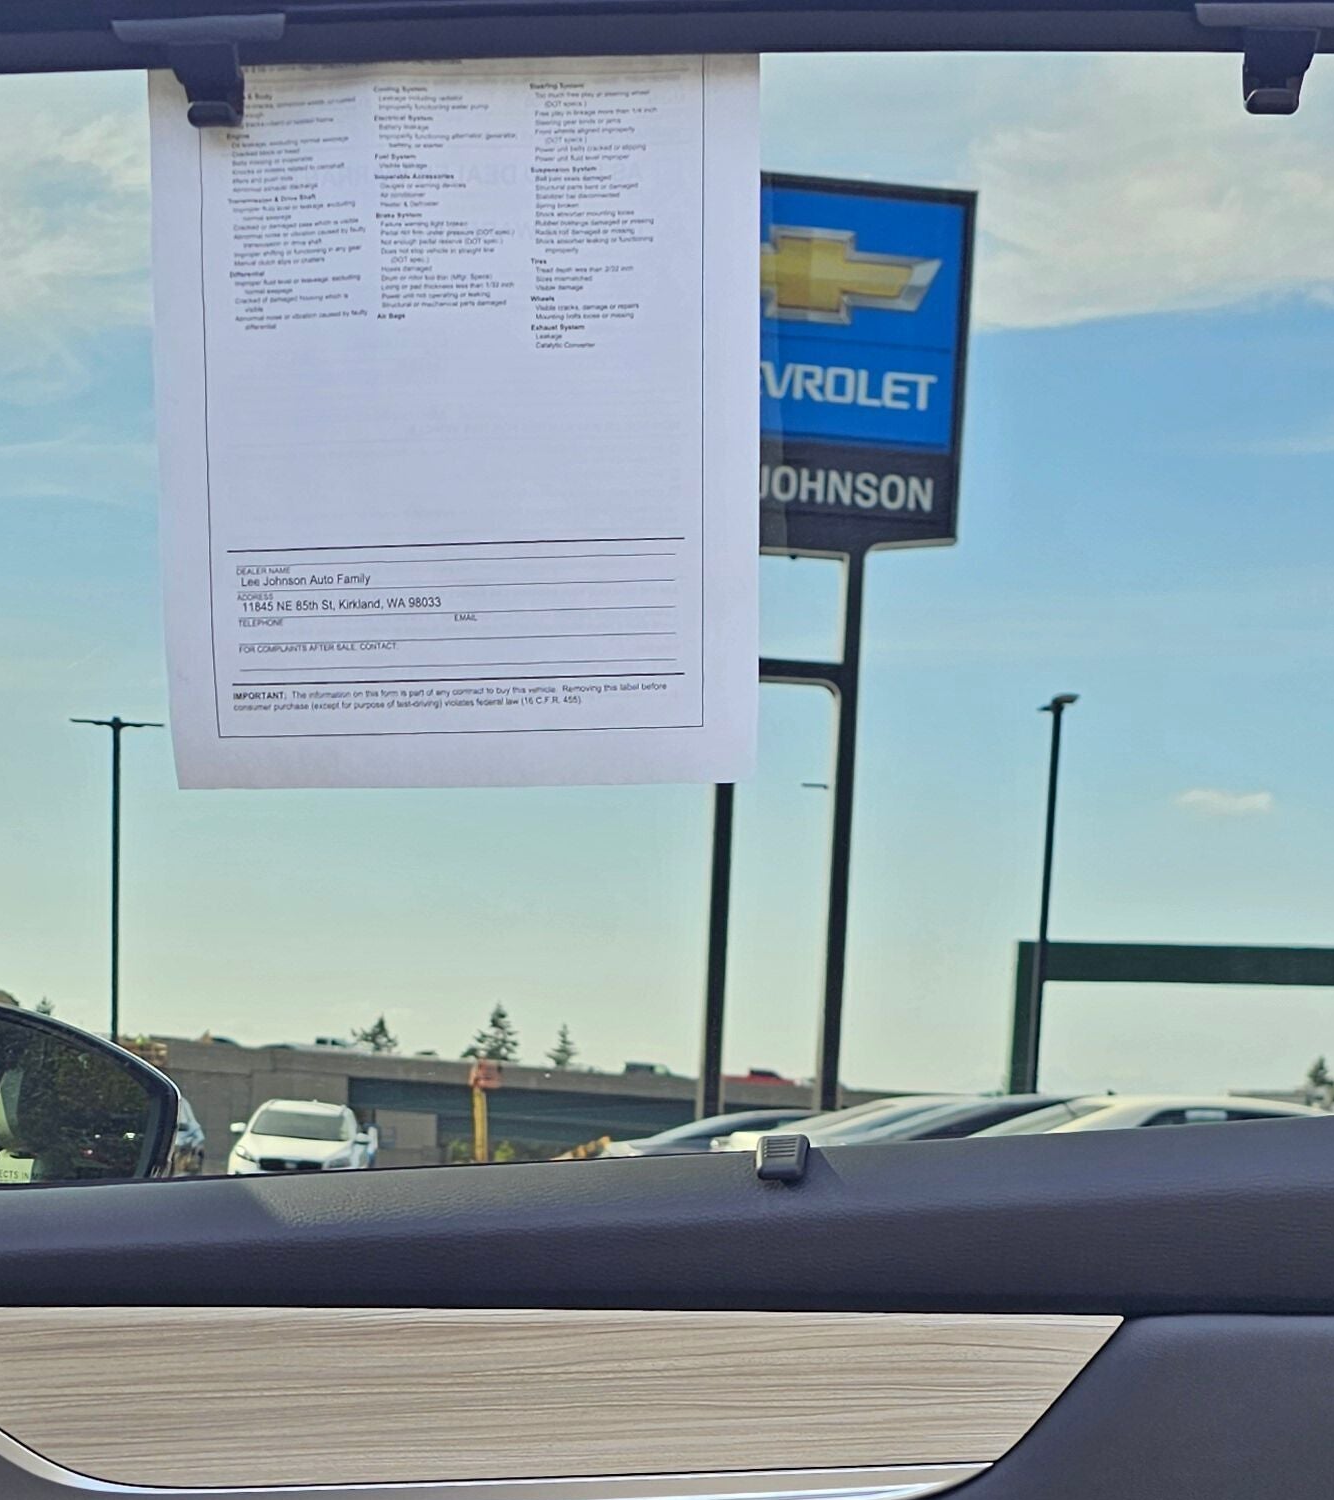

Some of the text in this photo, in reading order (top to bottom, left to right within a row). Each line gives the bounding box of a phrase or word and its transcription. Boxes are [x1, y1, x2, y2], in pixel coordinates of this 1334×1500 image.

[559, 324, 585, 332] System
[760, 361, 938, 411] VROLET
[236, 566, 290, 575] DEALER NAME
[241, 573, 371, 587] Lee Johnson Auto Family
[237, 593, 273, 601] ADDRESS
[243, 597, 442, 612] 11845 NE 85th St, Kirkland, WA 98033
[238, 619, 283, 627] TELEPHONE
[454, 614, 477, 622] EMAIL
[238, 645, 255, 654] FOR
[257, 644, 307, 653] COMPLAINTS
[309, 643, 335, 651] AFTER
[292, 691, 306, 699] The
[309, 690, 351, 699] information
[381, 689, 398, 697] form
[409, 688, 424, 698] part
[436, 689, 450, 698] any
[452, 688, 484, 696] contract
[497, 687, 510, 695] buy
[512, 686, 526, 694] this
[562, 685, 601, 693] Removing
[604, 684, 617, 692] this
[619, 683, 639, 691] label
[273, 702, 310, 712] purchase
[311, 701, 340, 711] (except
[341, 701, 351, 709] for
[353, 700, 384, 709] purpose
[387, 699, 395, 708] of
[397, 699, 442, 709] test-driving)
[445, 699, 474, 707] violates
[476, 698, 504, 706] federal
[521, 696, 533, 705] (16
